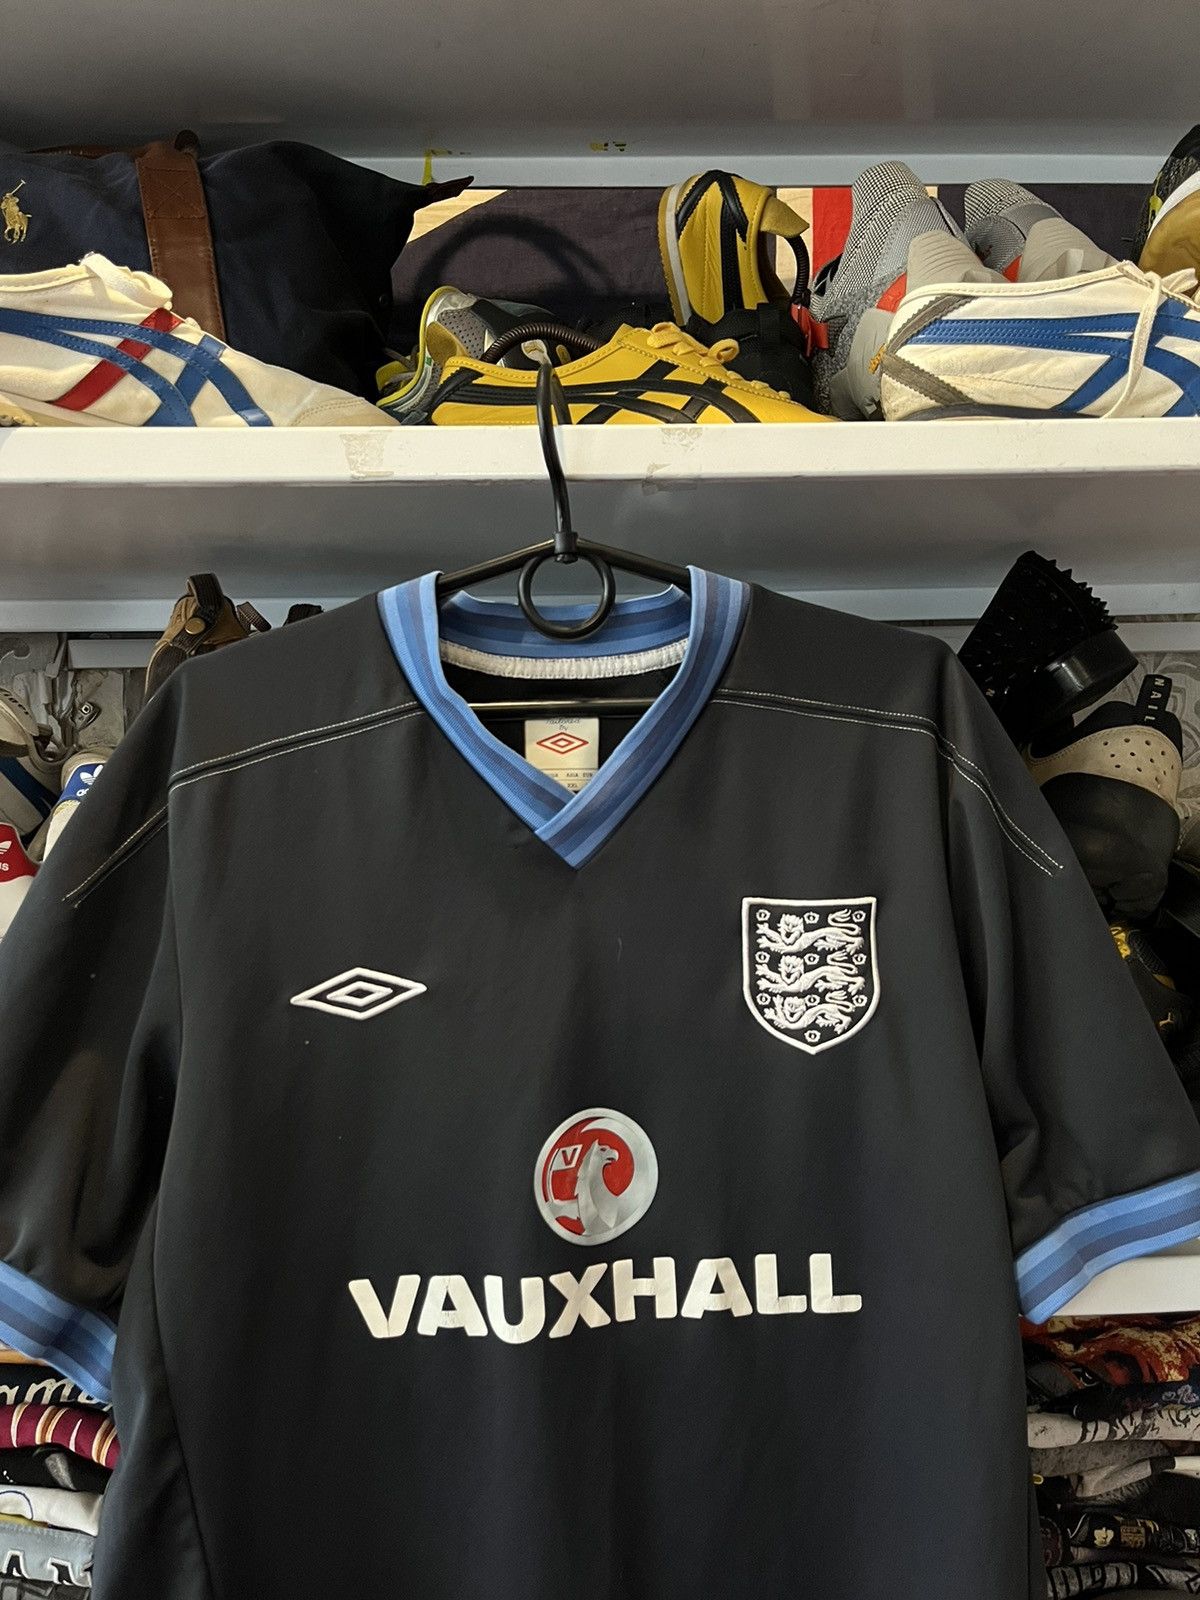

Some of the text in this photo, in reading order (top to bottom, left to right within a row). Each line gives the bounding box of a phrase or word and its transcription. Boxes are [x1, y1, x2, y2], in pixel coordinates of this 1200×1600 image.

[1144, 678, 1164, 722] NAIL
[559, 1147, 577, 1168] V
[348, 1252, 863, 1345] VAUXHALL
